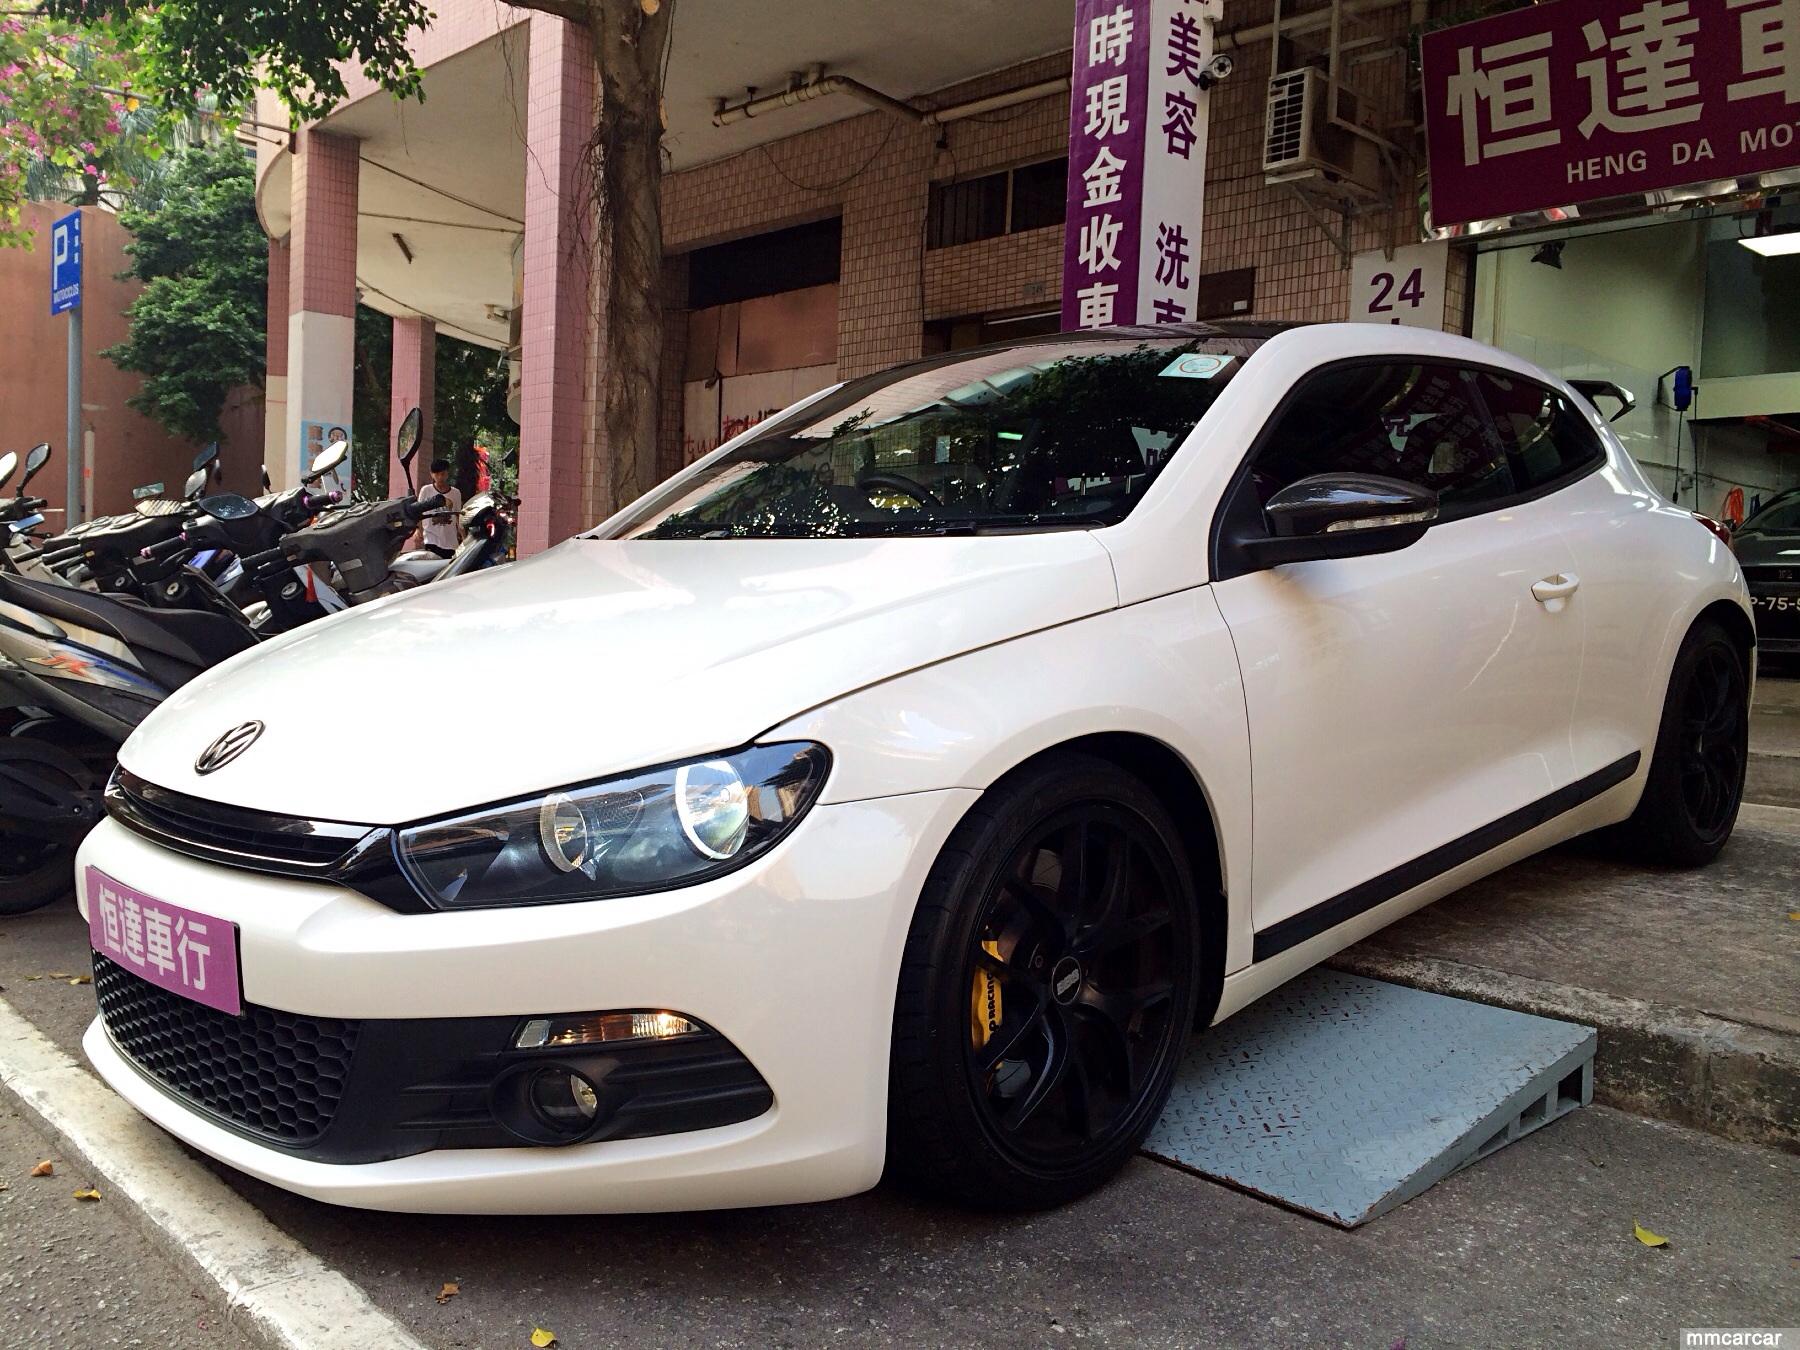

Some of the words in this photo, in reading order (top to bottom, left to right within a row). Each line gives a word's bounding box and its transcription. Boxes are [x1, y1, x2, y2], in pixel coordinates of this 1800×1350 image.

[1074, 4, 1134, 331] 時現金收車
[1567, 149, 1648, 184] HENG
[1671, 137, 1715, 167] DA
[1740, 121, 1800, 154] MO
[1368, 267, 1426, 314] 24
[98, 883, 211, 991] 恒達車行
